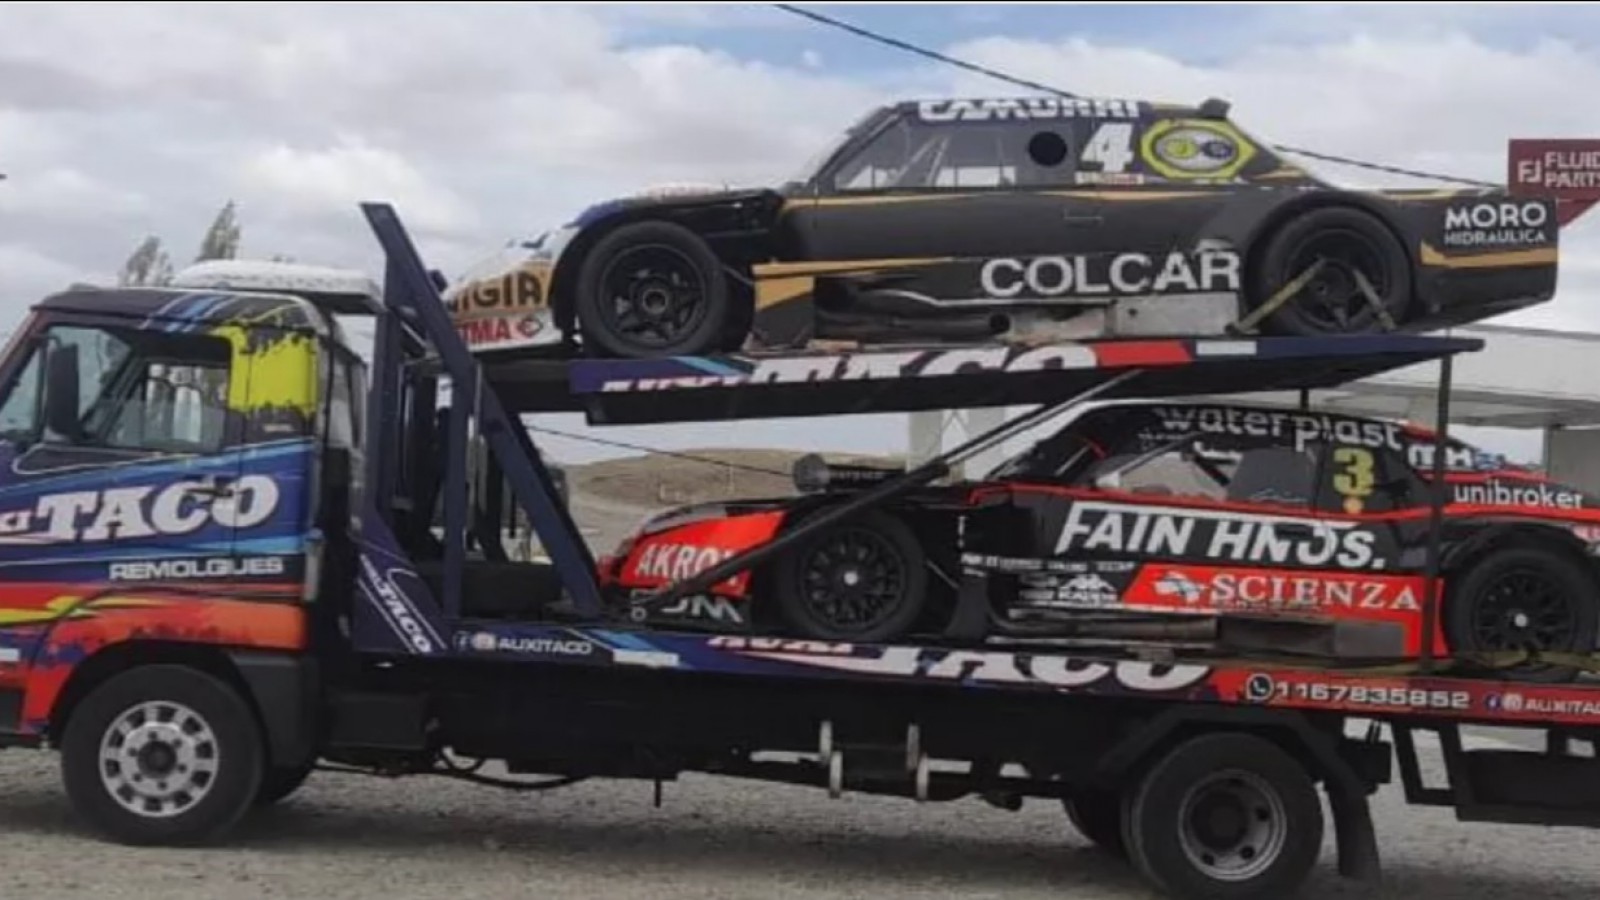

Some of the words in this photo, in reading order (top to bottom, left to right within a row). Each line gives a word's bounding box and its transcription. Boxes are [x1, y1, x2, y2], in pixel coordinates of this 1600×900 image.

[1081, 122, 1134, 173] 4
[1445, 203, 1547, 229] MORO
[1445, 230, 1546, 246] HIDRAULICA
[981, 252, 1240, 297] COLCAR
[1334, 447, 1374, 495] 3
[37, 473, 279, 541] TACO
[1454, 477, 1584, 508] unibroker
[1055, 501, 1193, 554] FAIN
[1211, 573, 1421, 611] SCIENZA
[498, 637, 592, 654] AUXITACO
